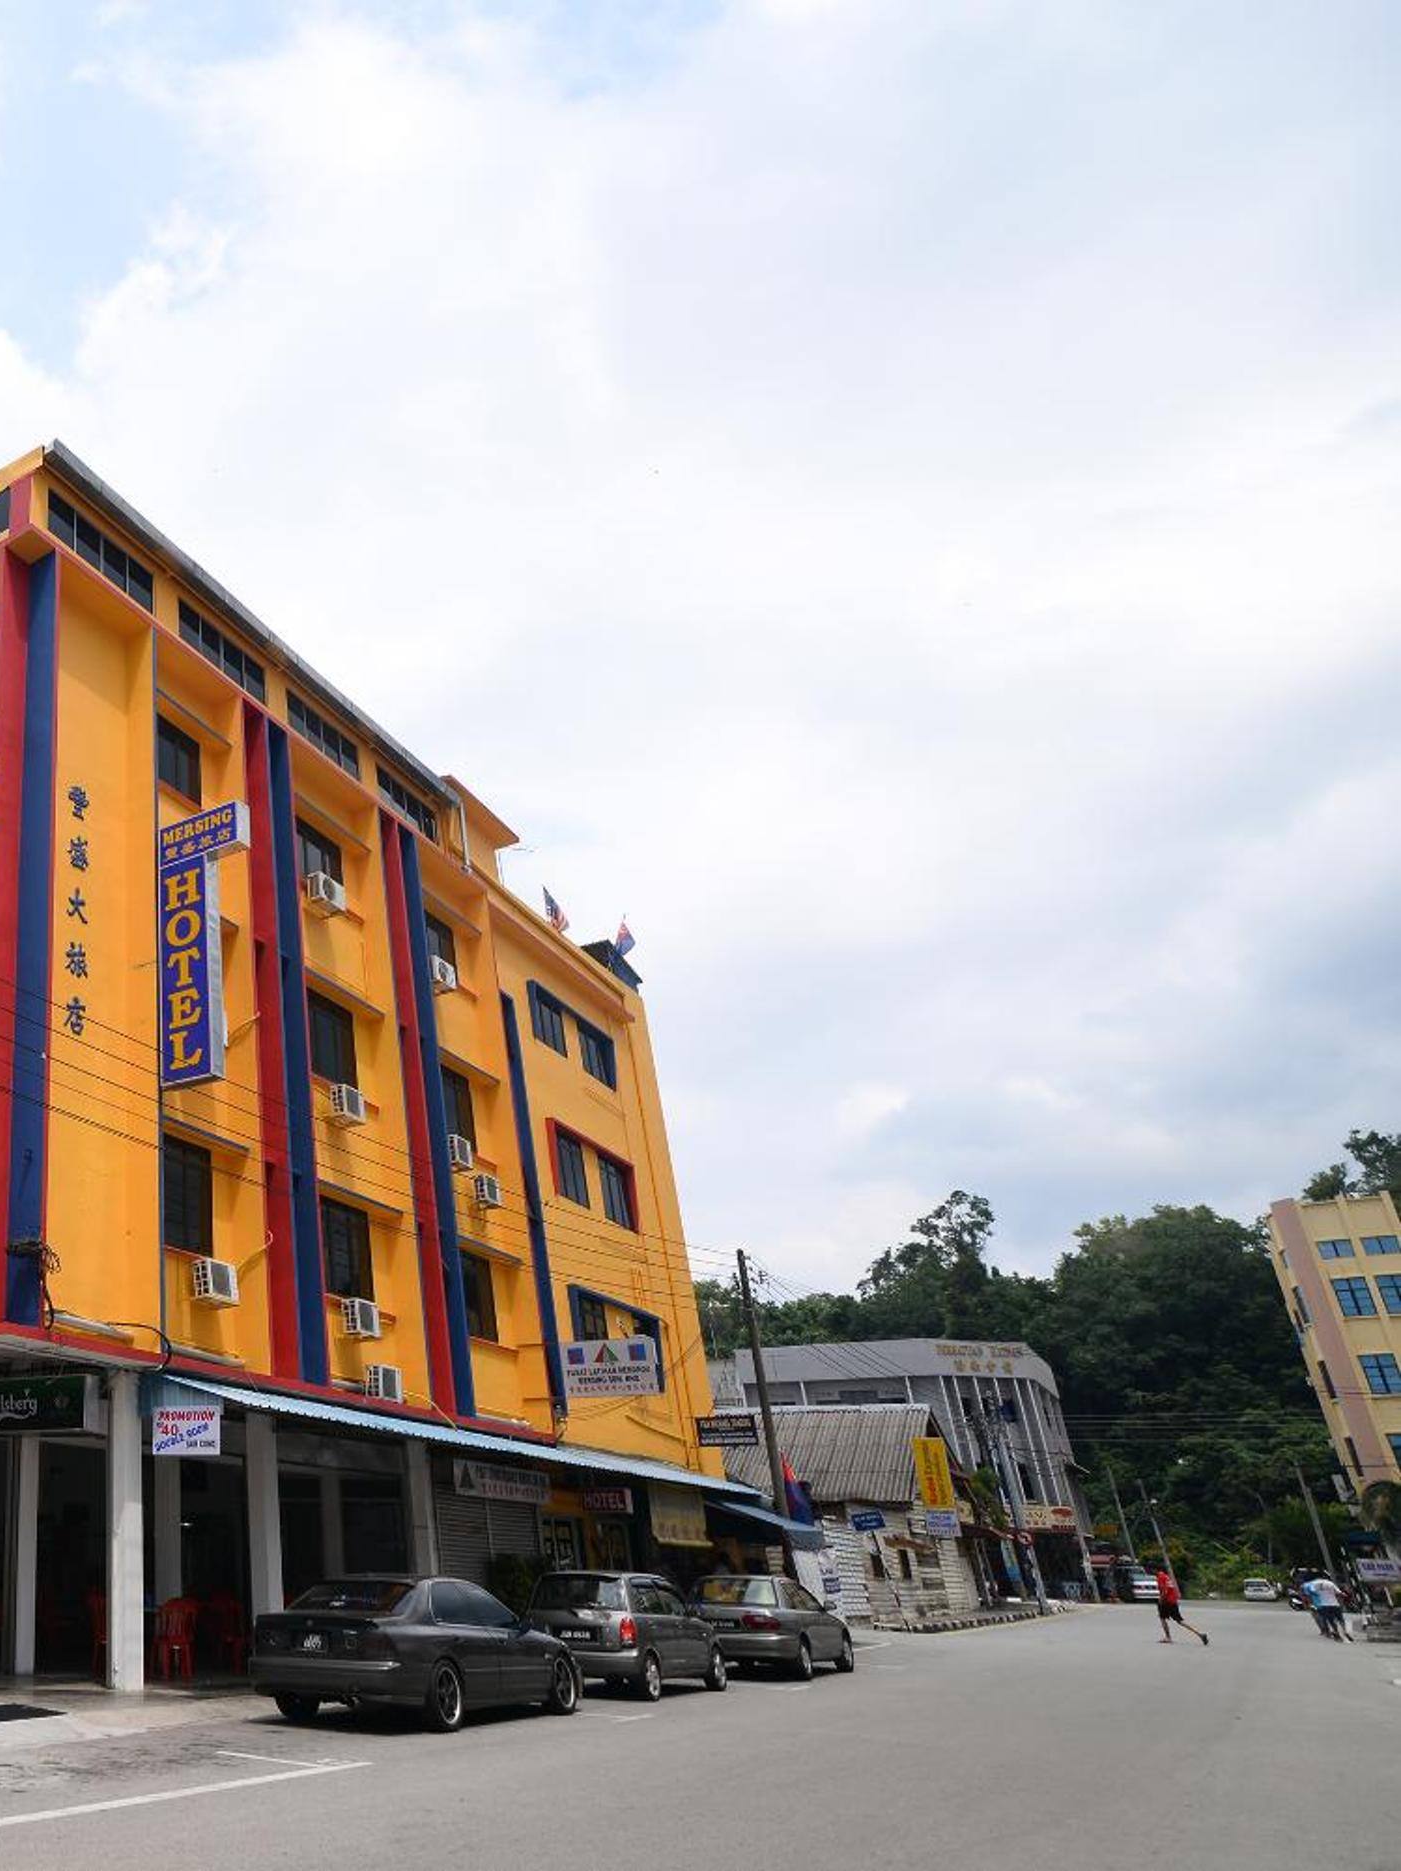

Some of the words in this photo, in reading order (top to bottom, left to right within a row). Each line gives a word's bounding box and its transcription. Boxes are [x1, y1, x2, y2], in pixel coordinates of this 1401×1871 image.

[163, 808, 233, 847] MERSING
[165, 867, 203, 1070] HOTEL
[158, 1409, 215, 1421] PROMOTION
[584, 1491, 626, 1511] HOTEL
